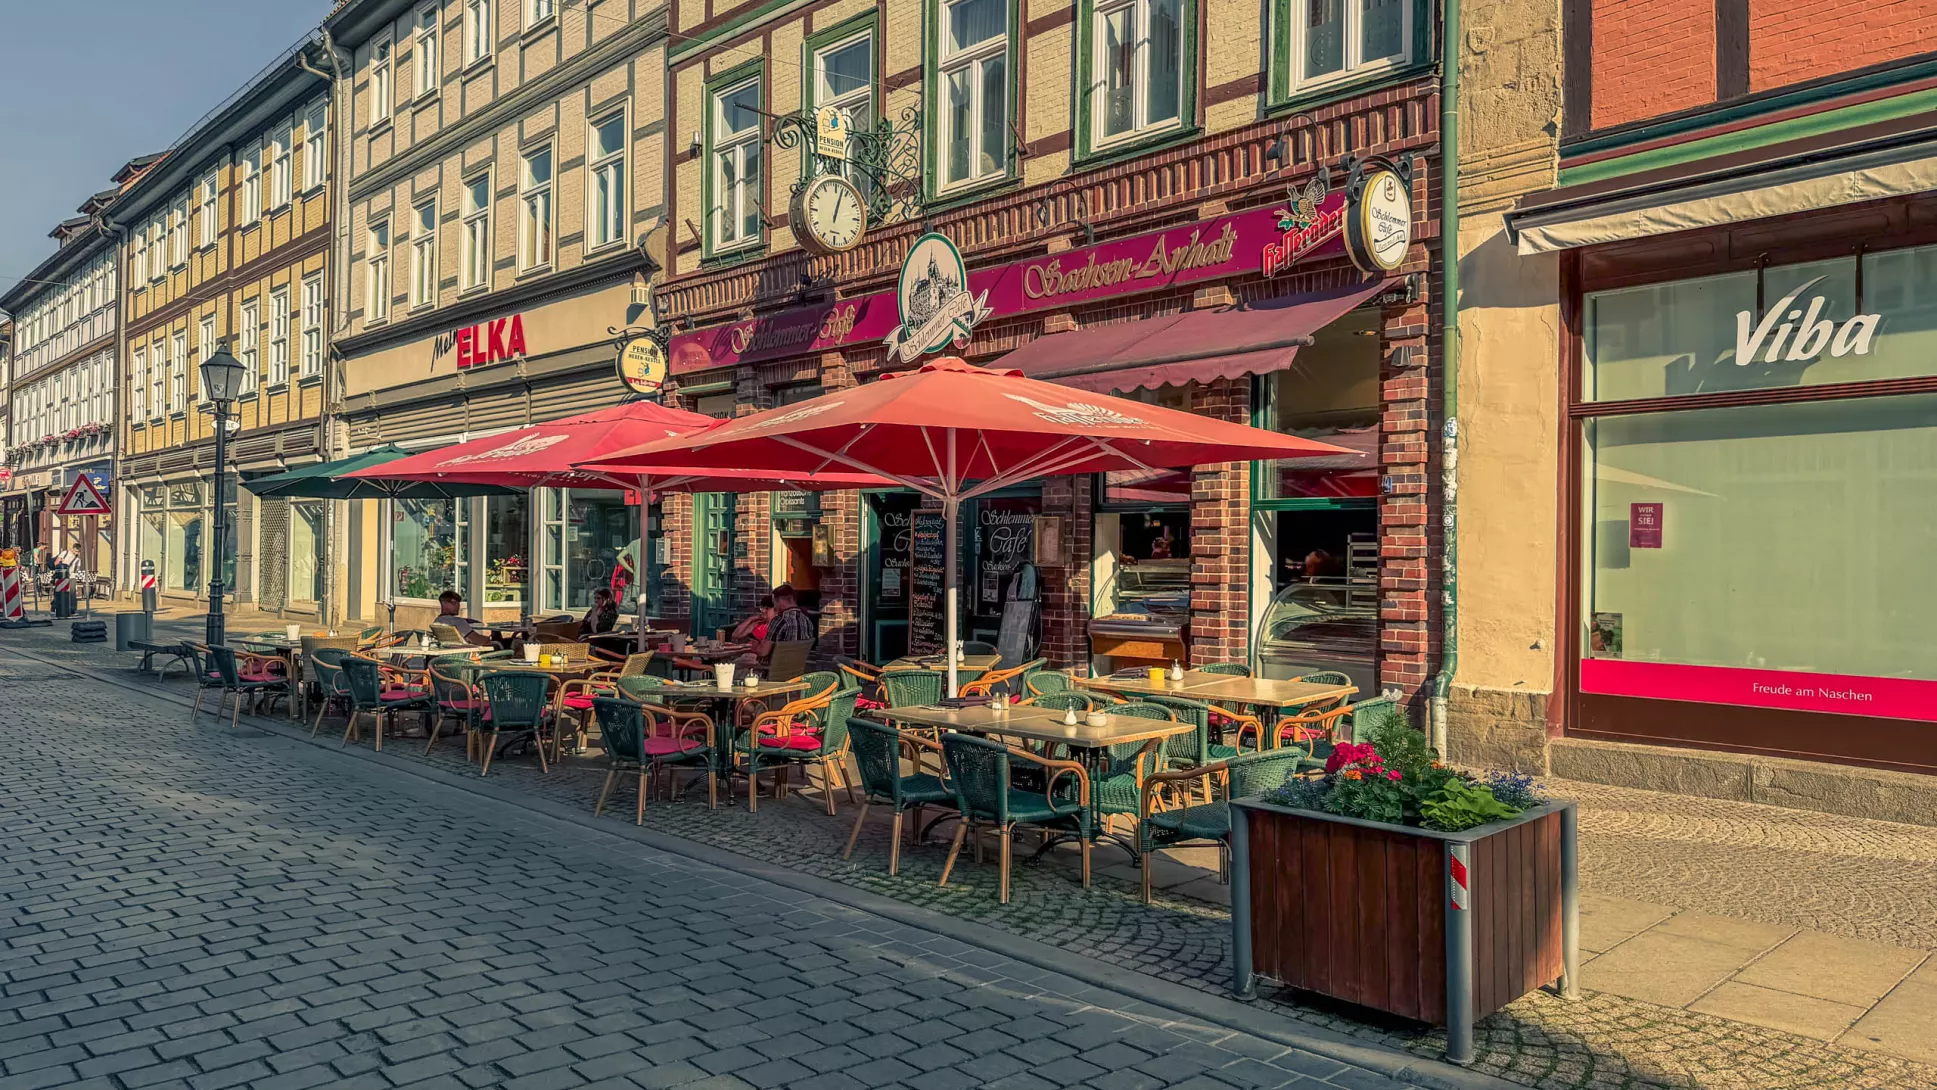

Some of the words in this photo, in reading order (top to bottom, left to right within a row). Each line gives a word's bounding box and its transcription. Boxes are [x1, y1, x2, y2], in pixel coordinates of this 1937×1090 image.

[819, 135, 844, 148] PENSION
[1371, 206, 1407, 228] Schlemmer
[1024, 222, 1238, 299] Sachsen-Anhalt
[902, 313, 946, 357] Schlemmer
[1735, 275, 1882, 366] Viba
[457, 313, 527, 371] ELKA
[632, 345, 658, 357] PENSION
[1638, 506, 1654, 514] WIR
[989, 526, 1032, 563] Café
[1753, 682, 1792, 696] Freude
[1795, 688, 1814, 697] am
[1819, 687, 1873, 702] Naschen
